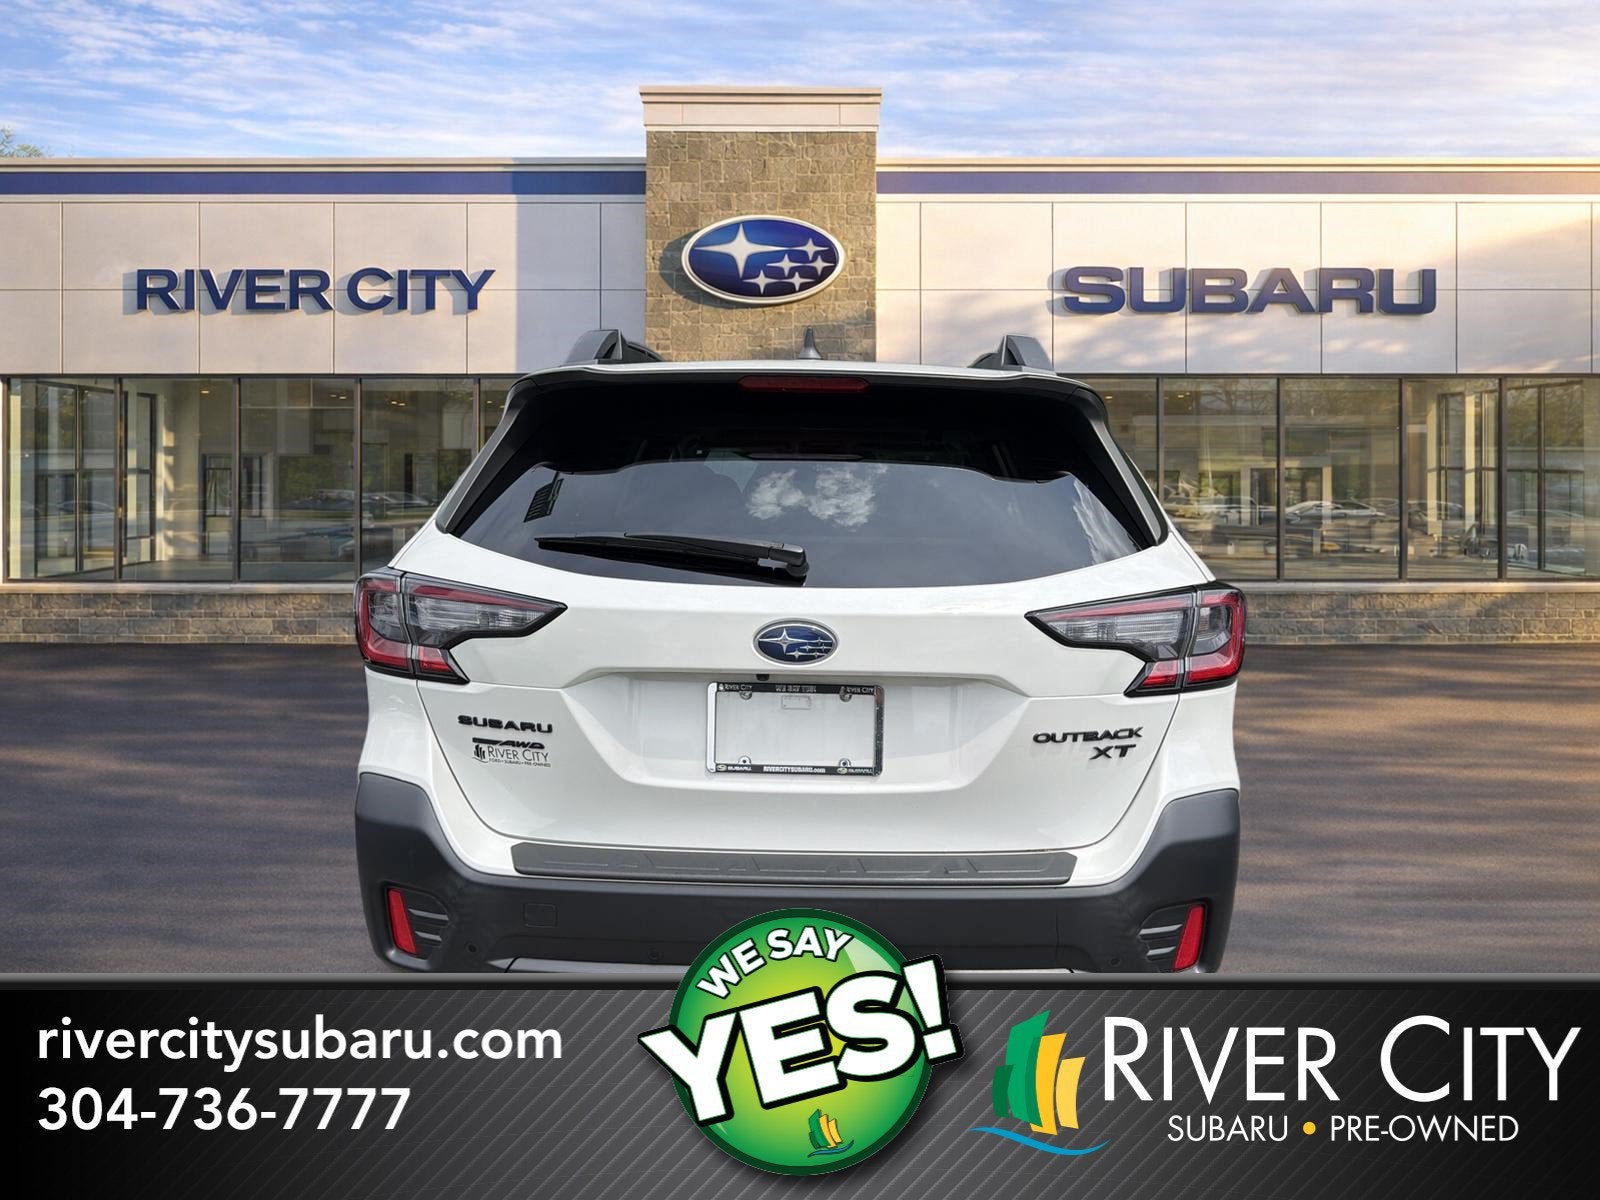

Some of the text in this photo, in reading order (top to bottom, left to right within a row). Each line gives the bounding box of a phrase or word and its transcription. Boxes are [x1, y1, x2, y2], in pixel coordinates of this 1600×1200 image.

[135, 267, 496, 311] RIVER CITY
[1062, 266, 1437, 315] SUBARU
[458, 715, 553, 734] SUBARU
[1033, 727, 1143, 744] OUTBACK
[487, 745, 549, 762] RIVER CITY
[499, 740, 545, 750] AWD
[1089, 744, 1137, 760] XT
